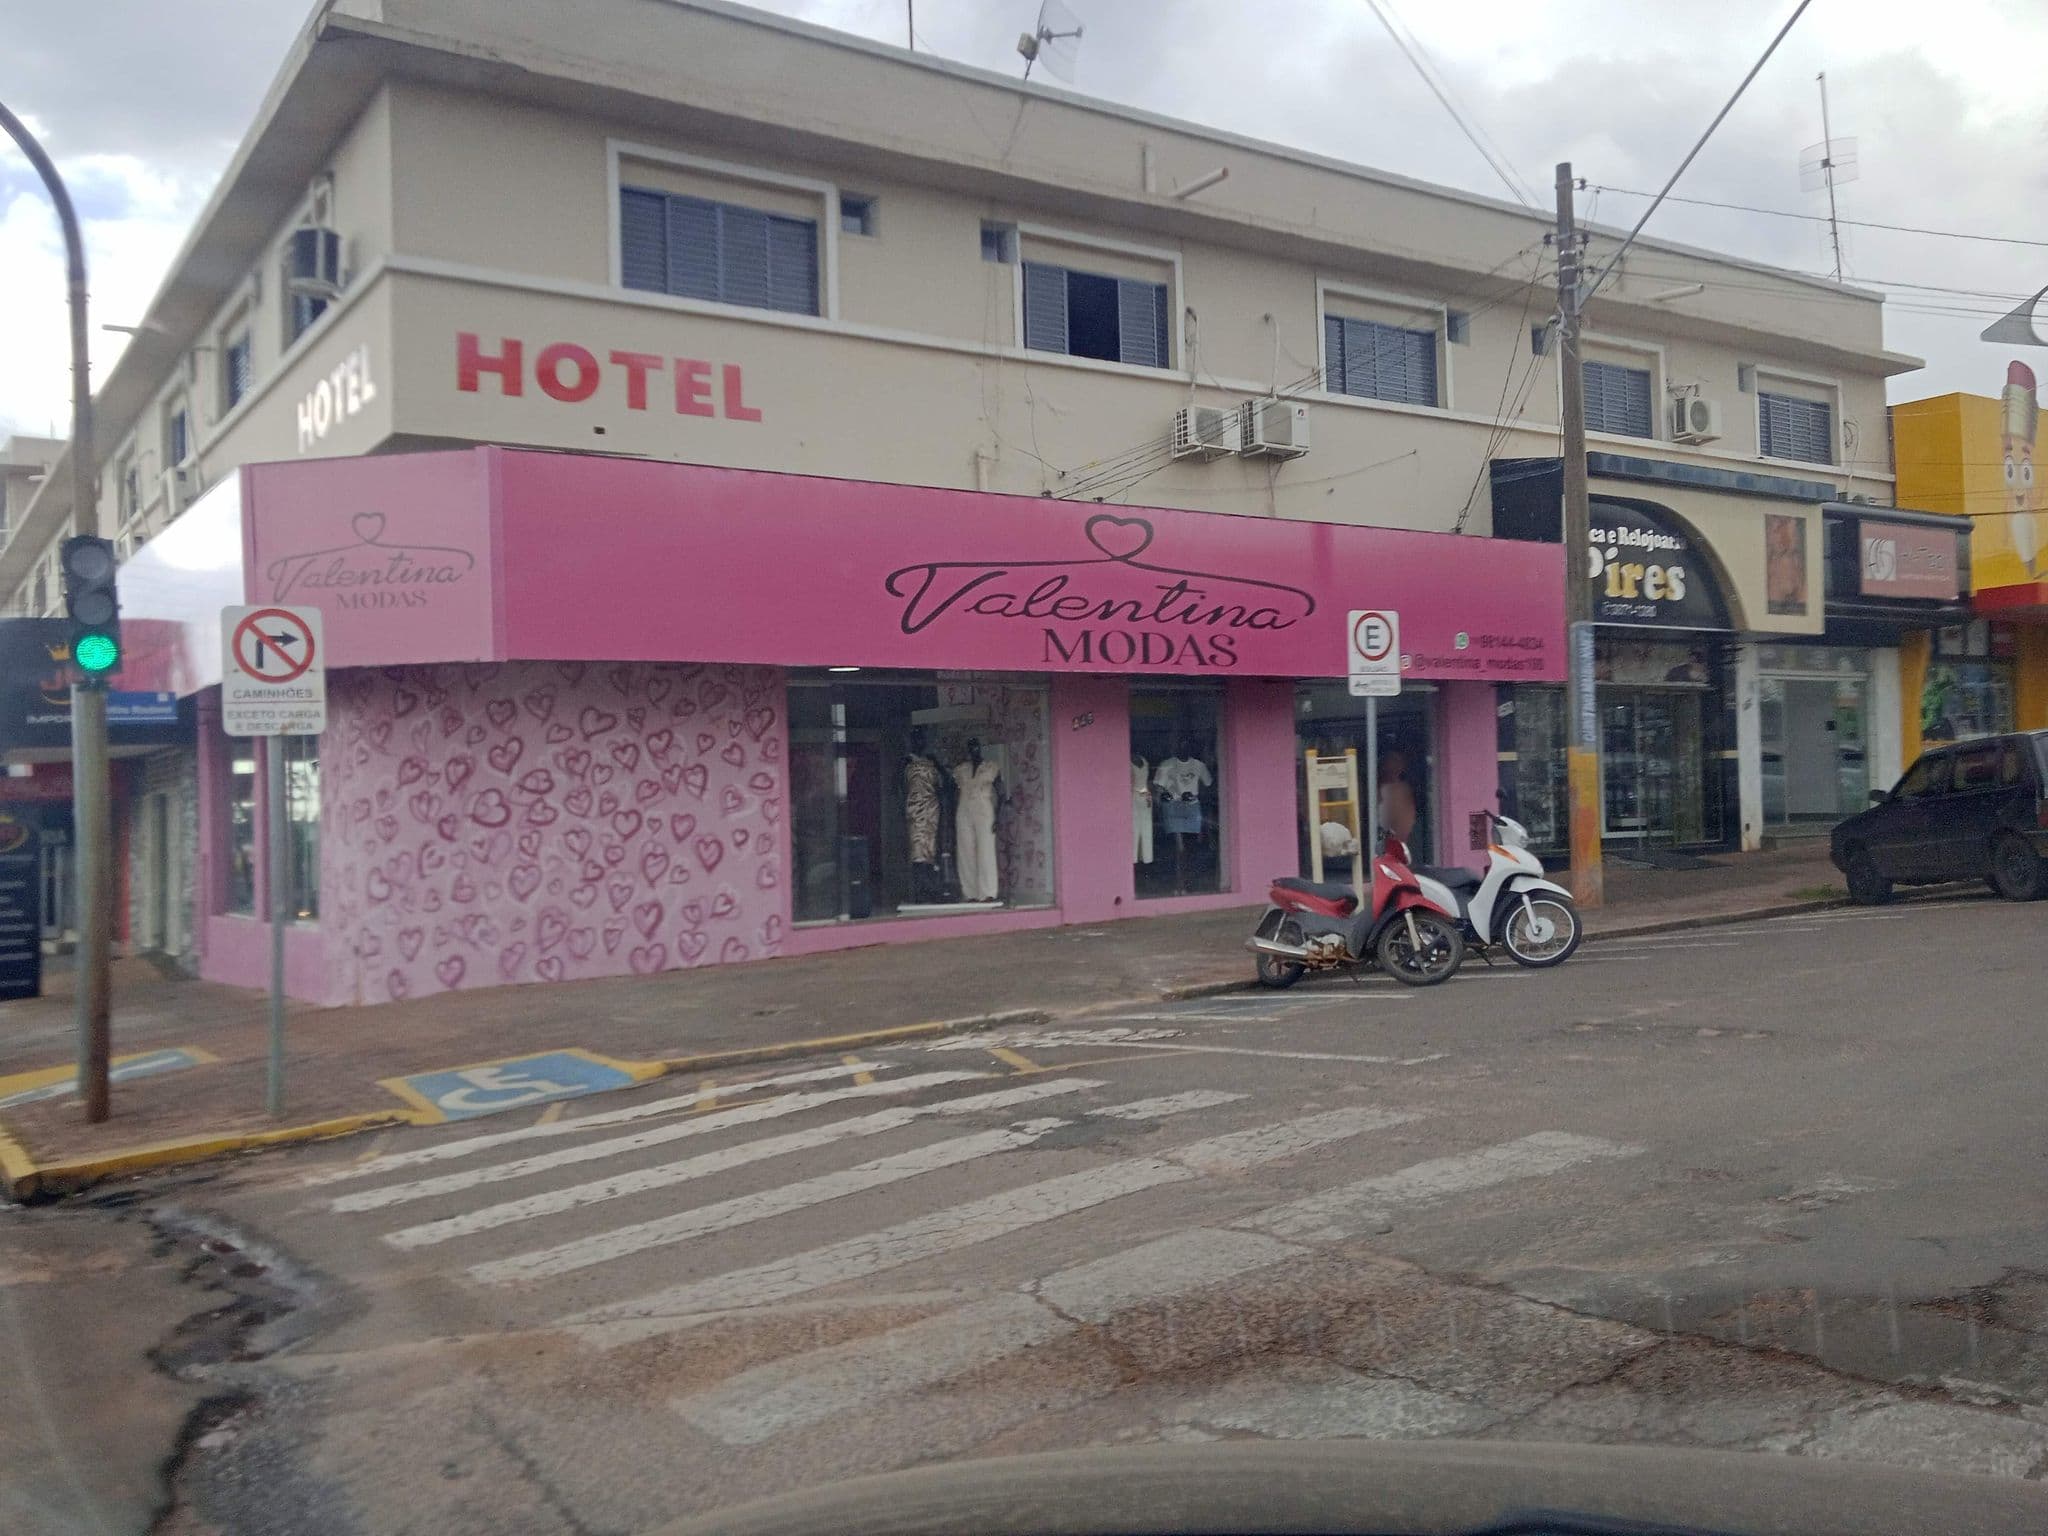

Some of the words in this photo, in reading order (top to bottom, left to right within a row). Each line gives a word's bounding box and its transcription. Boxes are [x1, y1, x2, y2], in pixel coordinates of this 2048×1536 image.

[455, 331, 762, 423] HOTEL
[297, 343, 377, 454] HOTEL
[267, 544, 474, 602] Valentina
[336, 589, 428, 609] MODAS
[886, 559, 1316, 635] Valentina
[1041, 628, 1238, 667] MODAS
[1366, 625, 1381, 649] E
[233, 687, 313, 699] CAMINHÕES
[227, 710, 275, 720] EXCETO
[278, 710, 321, 719] CARGA
[247, 721, 313, 731] DESCARGA
